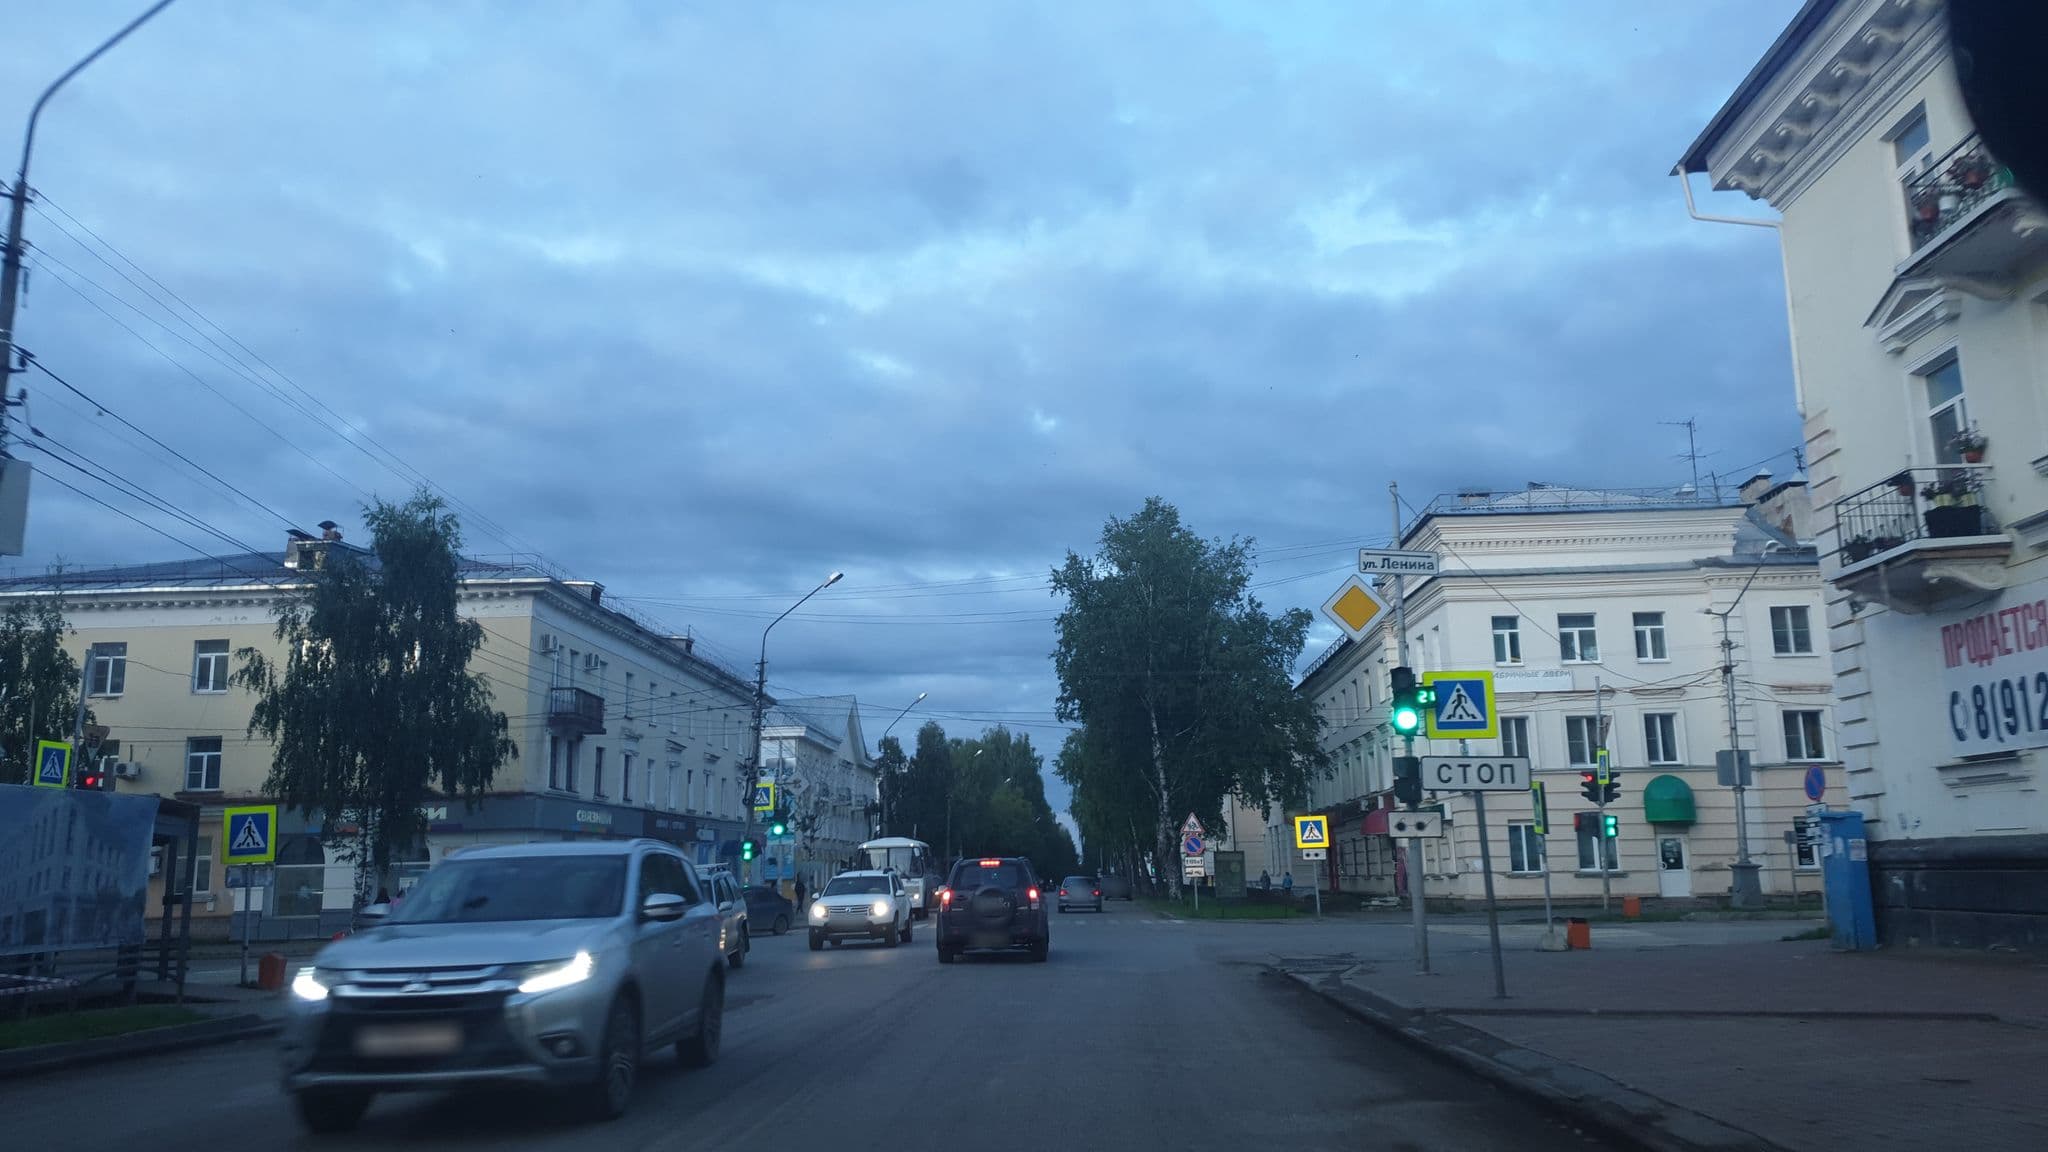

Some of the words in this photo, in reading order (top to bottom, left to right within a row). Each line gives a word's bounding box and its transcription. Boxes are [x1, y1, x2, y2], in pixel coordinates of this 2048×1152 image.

[1362, 560, 1377, 571] ул.
[1381, 558, 1434, 571] Ленина
[1941, 600, 2048, 668] ПРОДАЕТСЯ
[1494, 671, 1539, 679] АБРИЧНЫЕ
[1417, 690, 1436, 703] 21
[1437, 764, 1515, 785] СТОП
